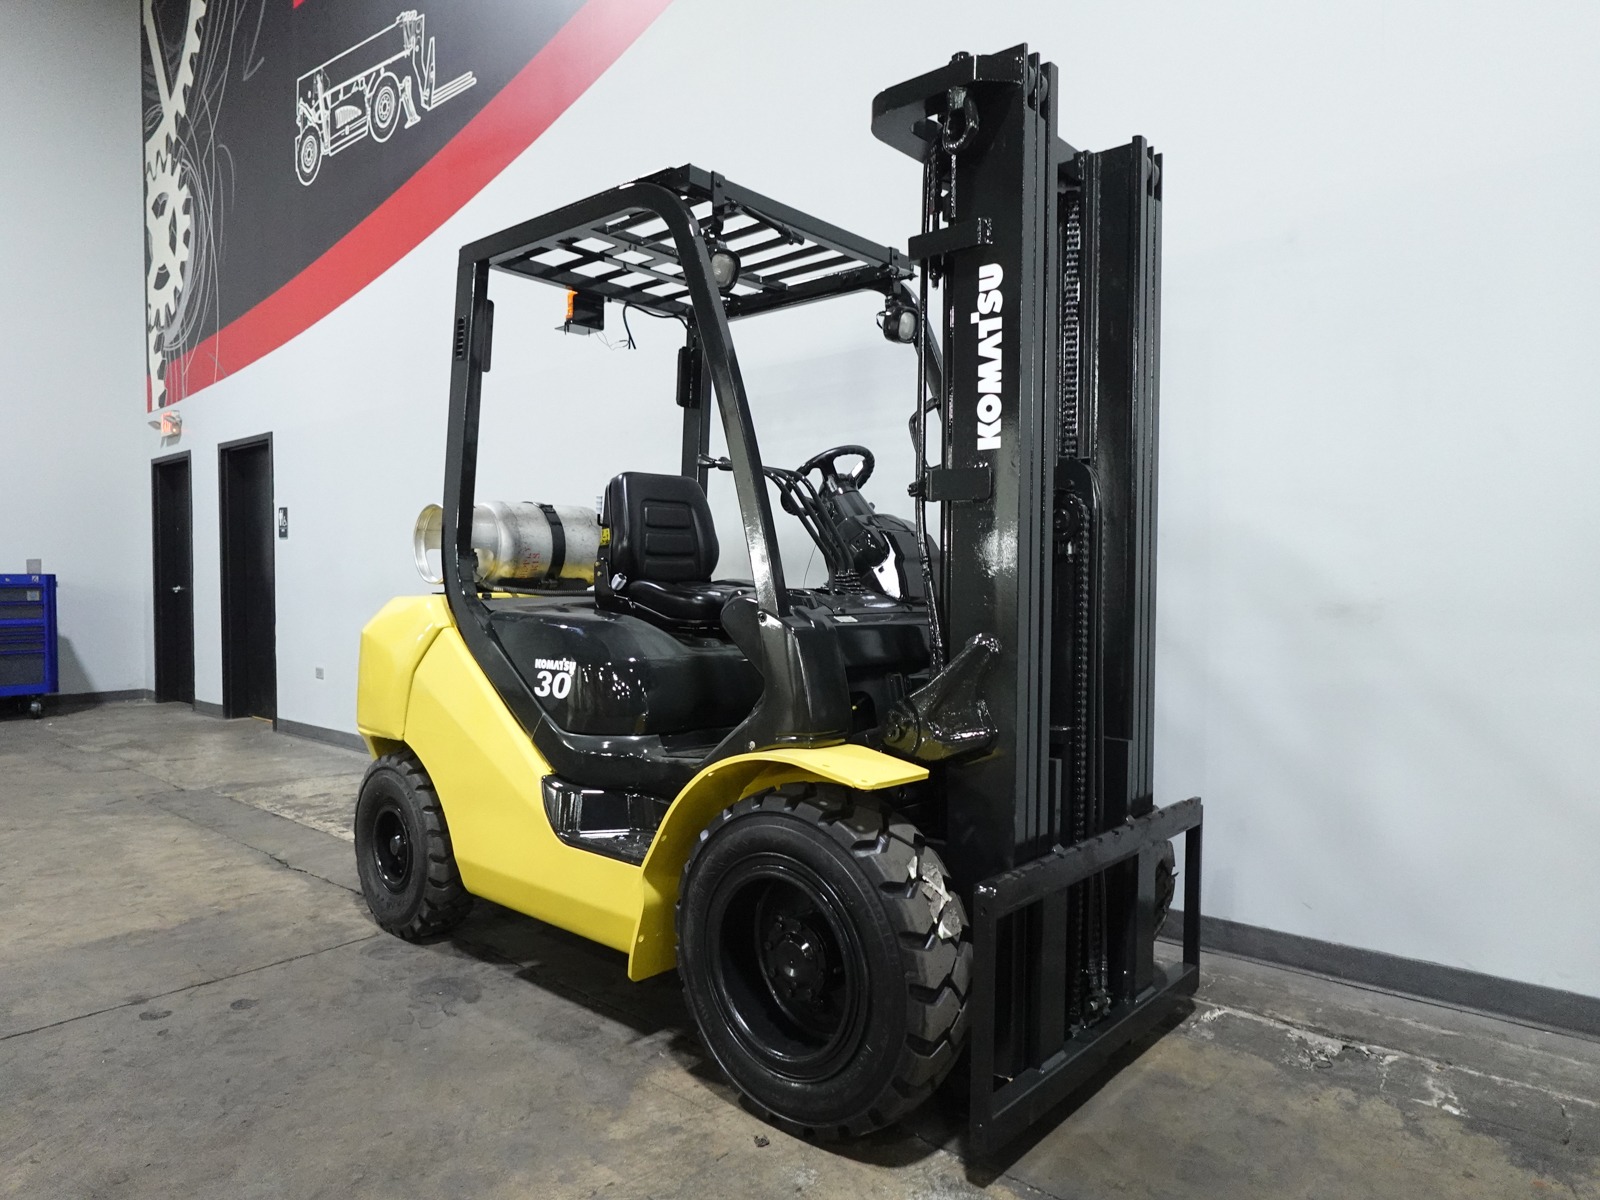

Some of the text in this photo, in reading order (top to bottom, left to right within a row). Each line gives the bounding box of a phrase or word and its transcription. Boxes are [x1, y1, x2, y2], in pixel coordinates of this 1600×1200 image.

[971, 263, 1003, 450] KOMATSU
[535, 658, 577, 673] KOMATSU
[534, 671, 571, 699] 30
